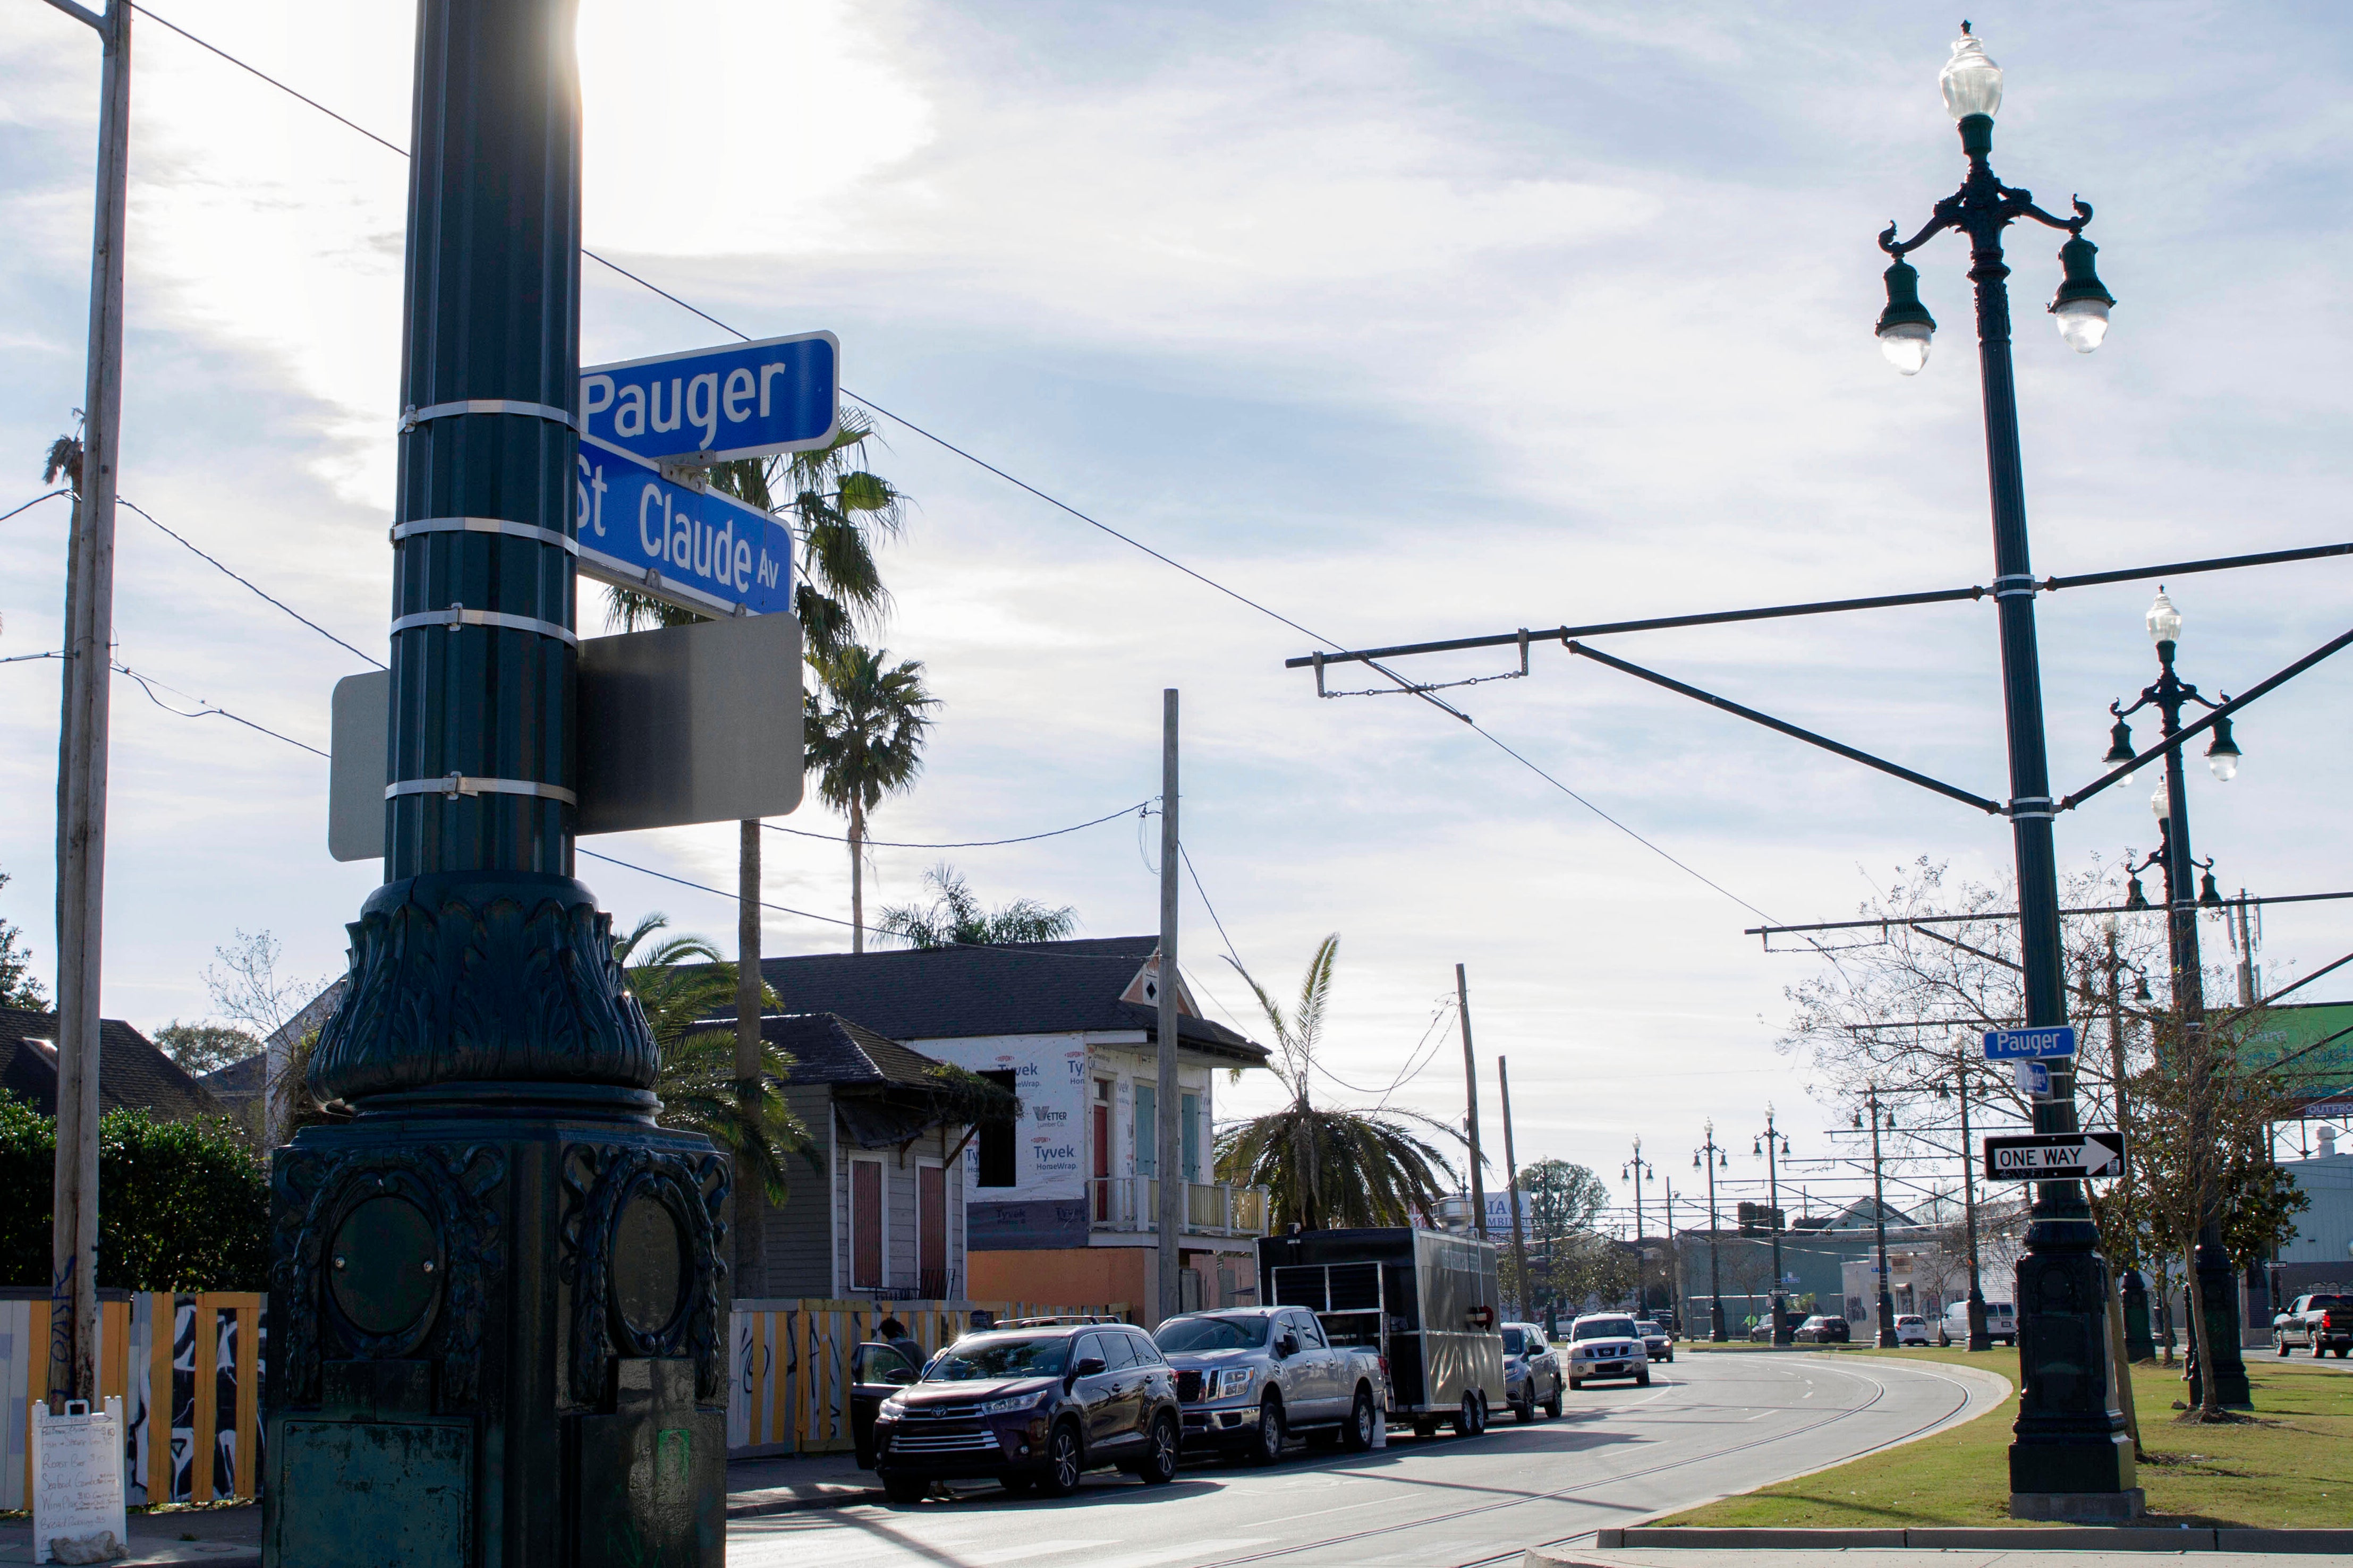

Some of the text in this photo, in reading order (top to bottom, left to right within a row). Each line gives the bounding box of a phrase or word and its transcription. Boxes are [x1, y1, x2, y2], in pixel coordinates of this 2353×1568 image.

[580, 363, 786, 450] Pauger
[640, 483, 752, 593] Claude
[757, 548, 779, 590] Av
[1997, 1032, 2060, 1056] Pauger
[1033, 1106, 1067, 1121] VETTER
[1033, 1145, 1074, 1162] Tyvek
[2000, 1147, 2082, 1167] ONE WAY
